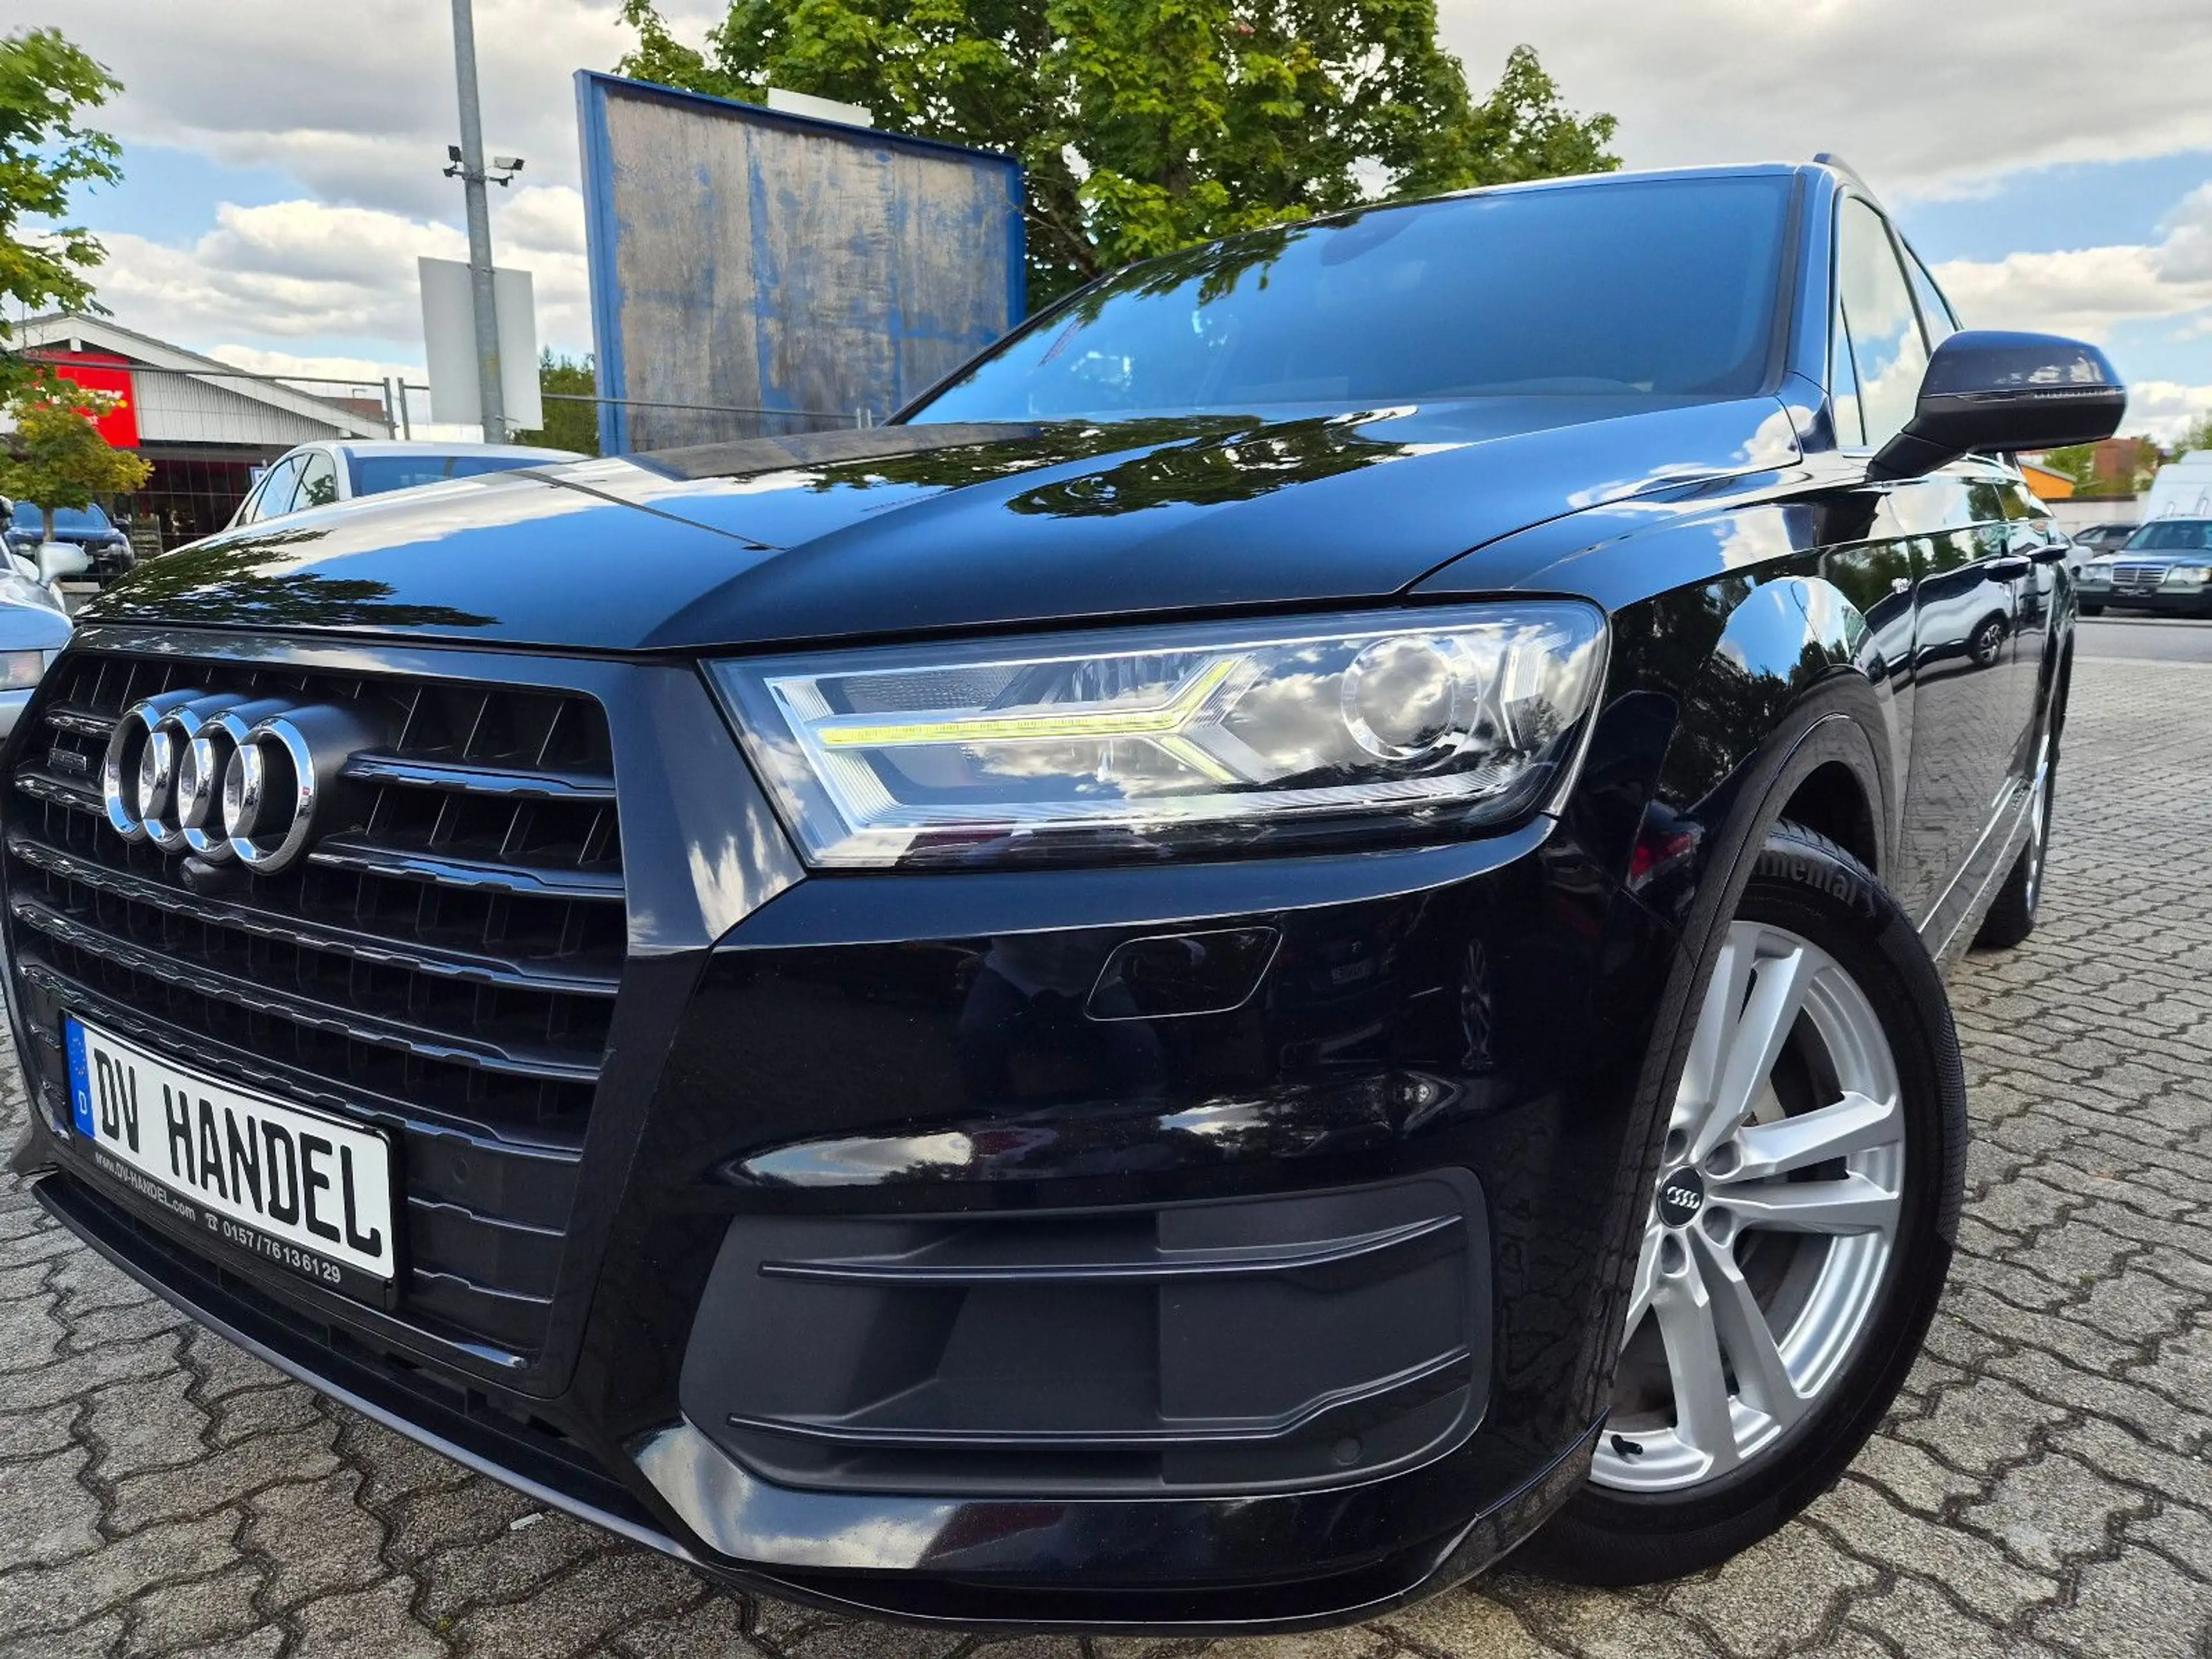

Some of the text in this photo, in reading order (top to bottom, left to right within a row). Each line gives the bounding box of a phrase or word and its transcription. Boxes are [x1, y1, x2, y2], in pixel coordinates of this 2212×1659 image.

[78, 1090, 88, 1115] D
[94, 1047, 382, 1257] DV HANDEL
